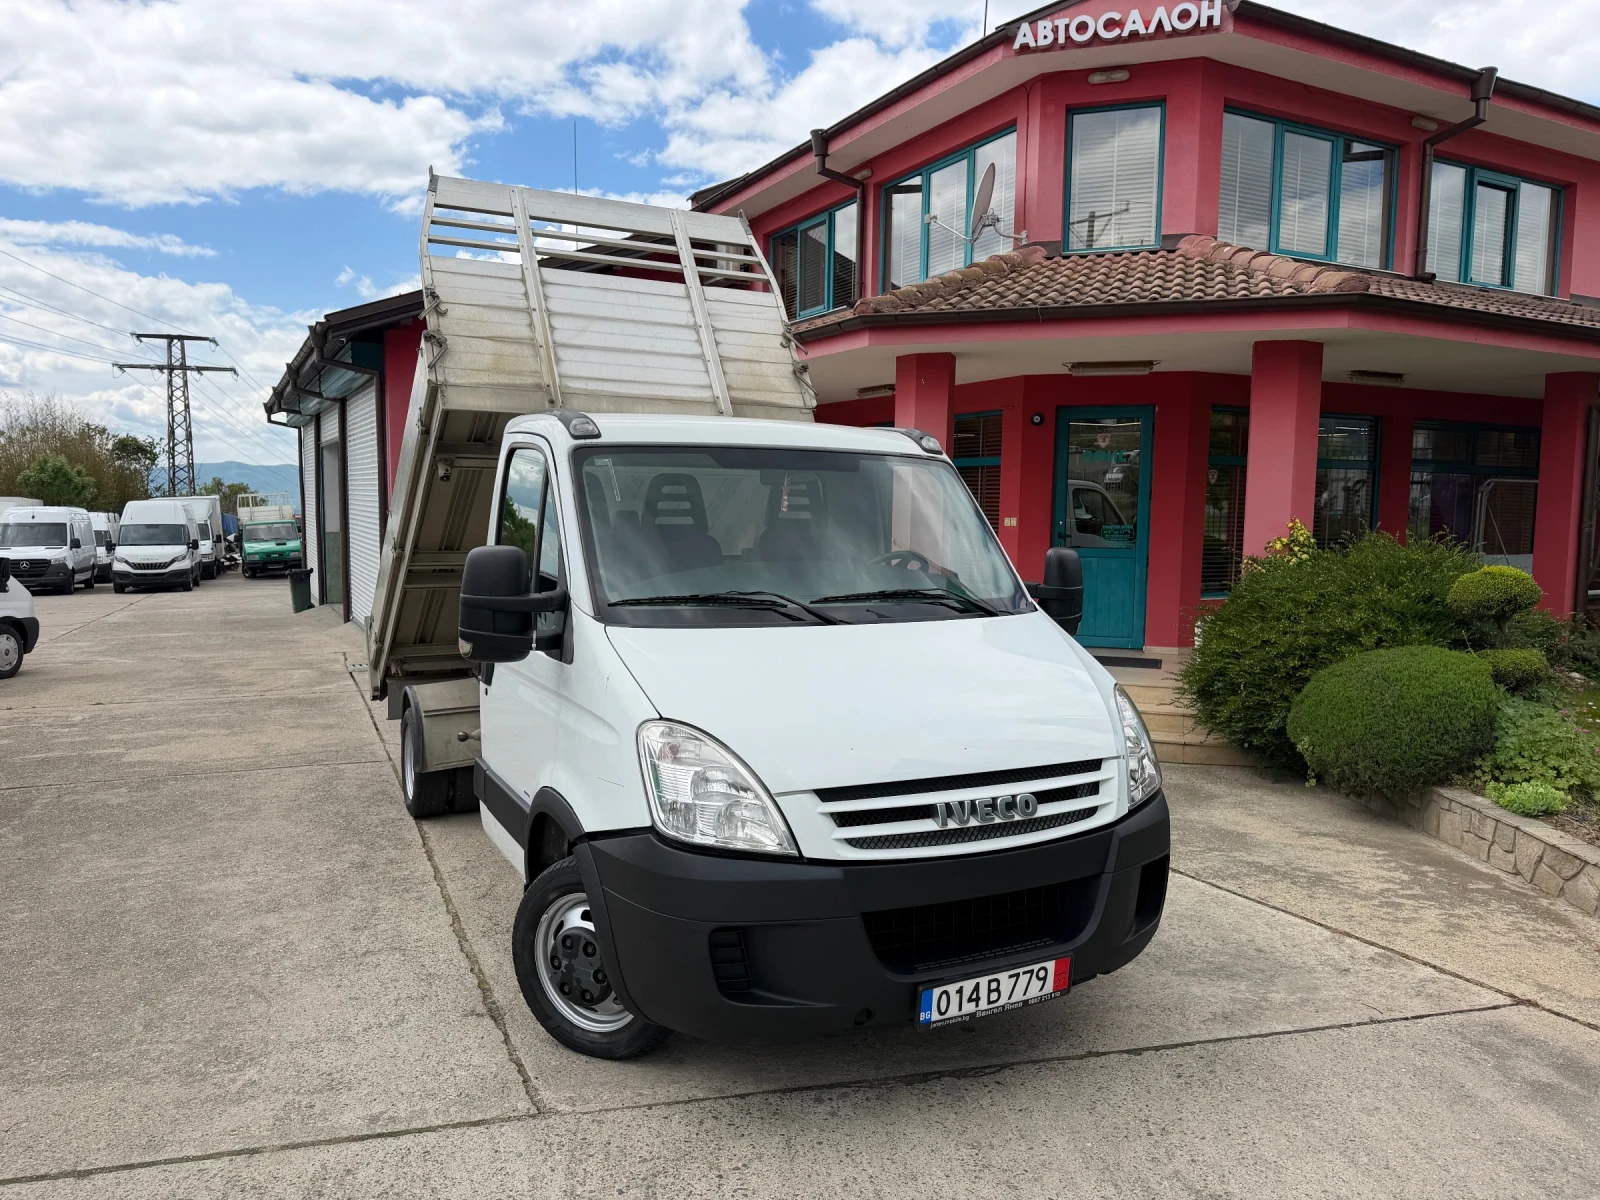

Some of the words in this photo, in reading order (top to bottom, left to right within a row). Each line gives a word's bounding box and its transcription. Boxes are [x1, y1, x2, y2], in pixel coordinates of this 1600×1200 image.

[1012, 0, 1222, 50] АВТОСАЛОН
[1082, 448, 1127, 464] ОФИС
[935, 793, 1038, 828] IVECO
[937, 966, 1049, 1017] 014B779
[920, 1011, 931, 1021] BG
[1004, 1002, 1023, 1012] Янев
